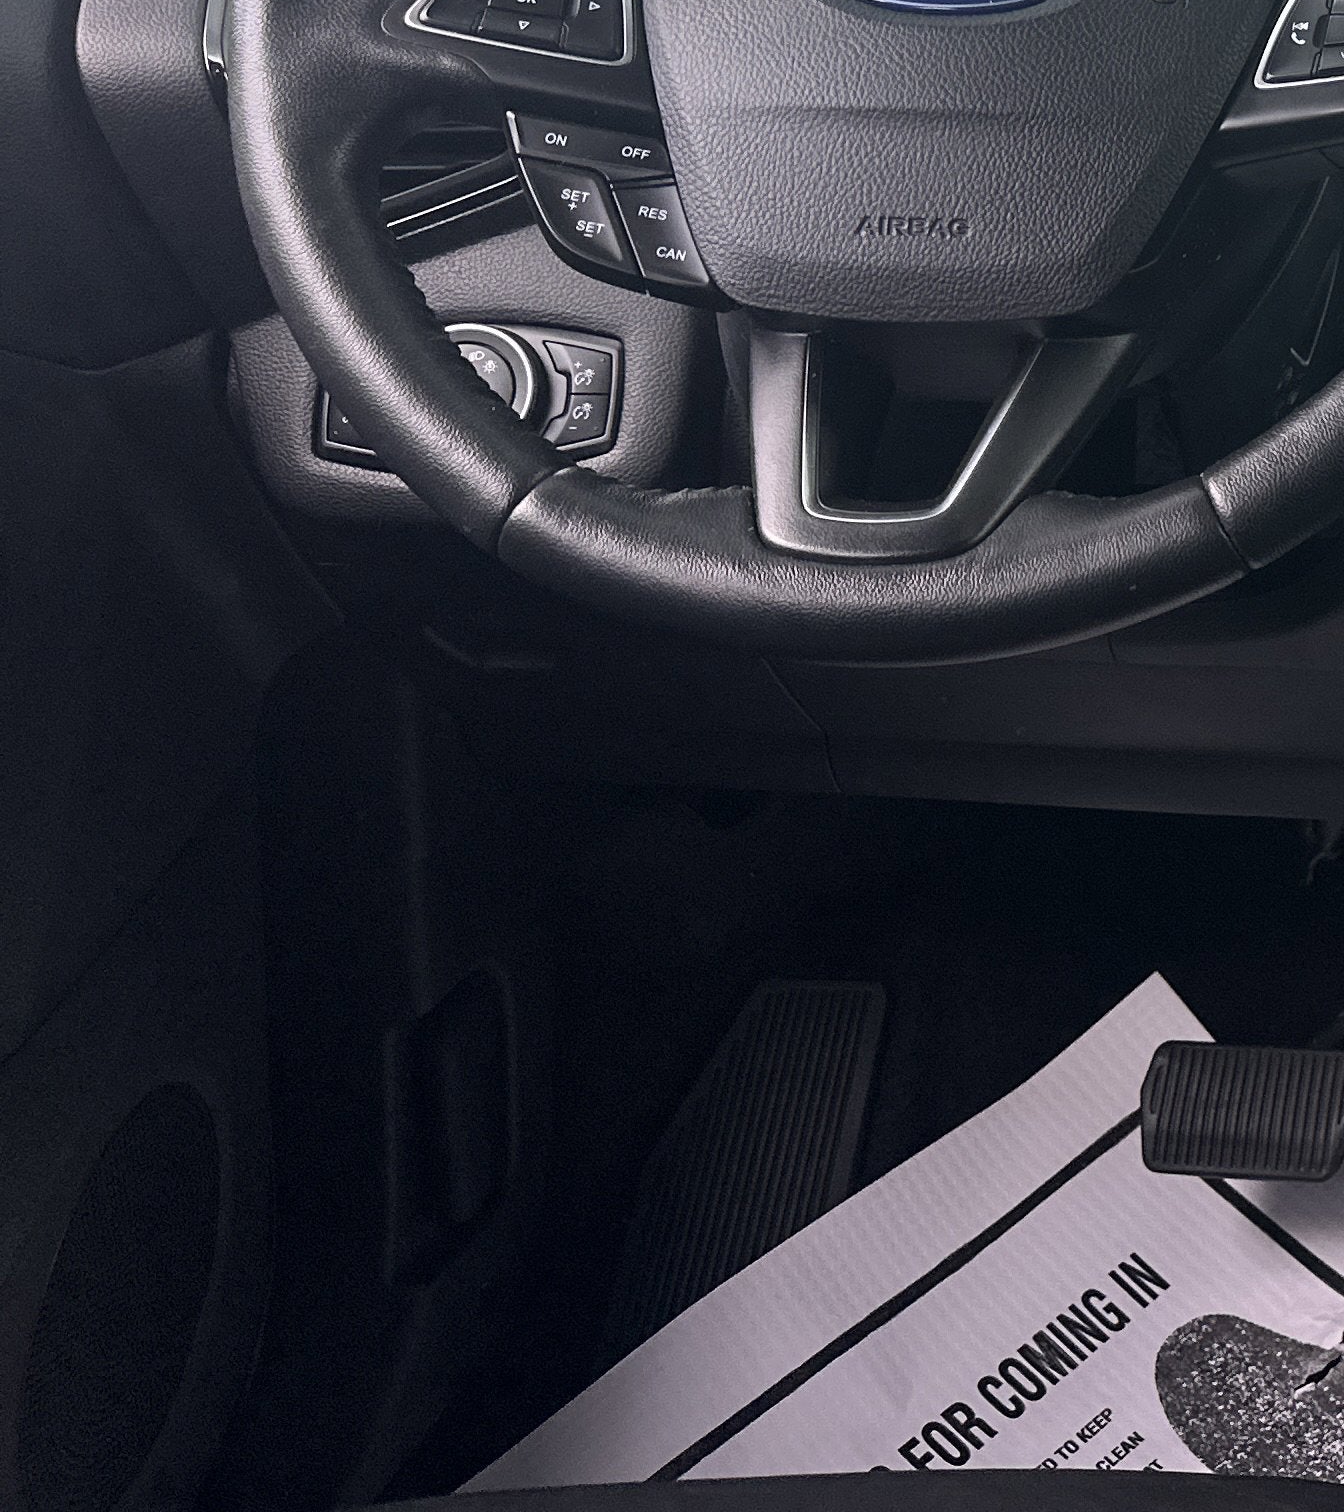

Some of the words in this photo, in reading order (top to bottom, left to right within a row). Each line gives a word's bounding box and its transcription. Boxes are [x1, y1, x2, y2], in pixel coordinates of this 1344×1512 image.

[544, 132, 568, 146] ON
[621, 145, 651, 160] OFF
[560, 188, 590, 203] SET
[638, 206, 668, 221] RES
[575, 220, 605, 235] SET
[855, 215, 970, 239] AIRBAG
[656, 246, 687, 262] CAN
[897, 1401, 999, 1471] FOR
[976, 1288, 1131, 1419] COMING
[1108, 1252, 1171, 1309] IN
[1053, 1439, 1080, 1461] TO
[1075, 1407, 1113, 1445] KEEP
[1095, 1430, 1146, 1472] CLEAN
